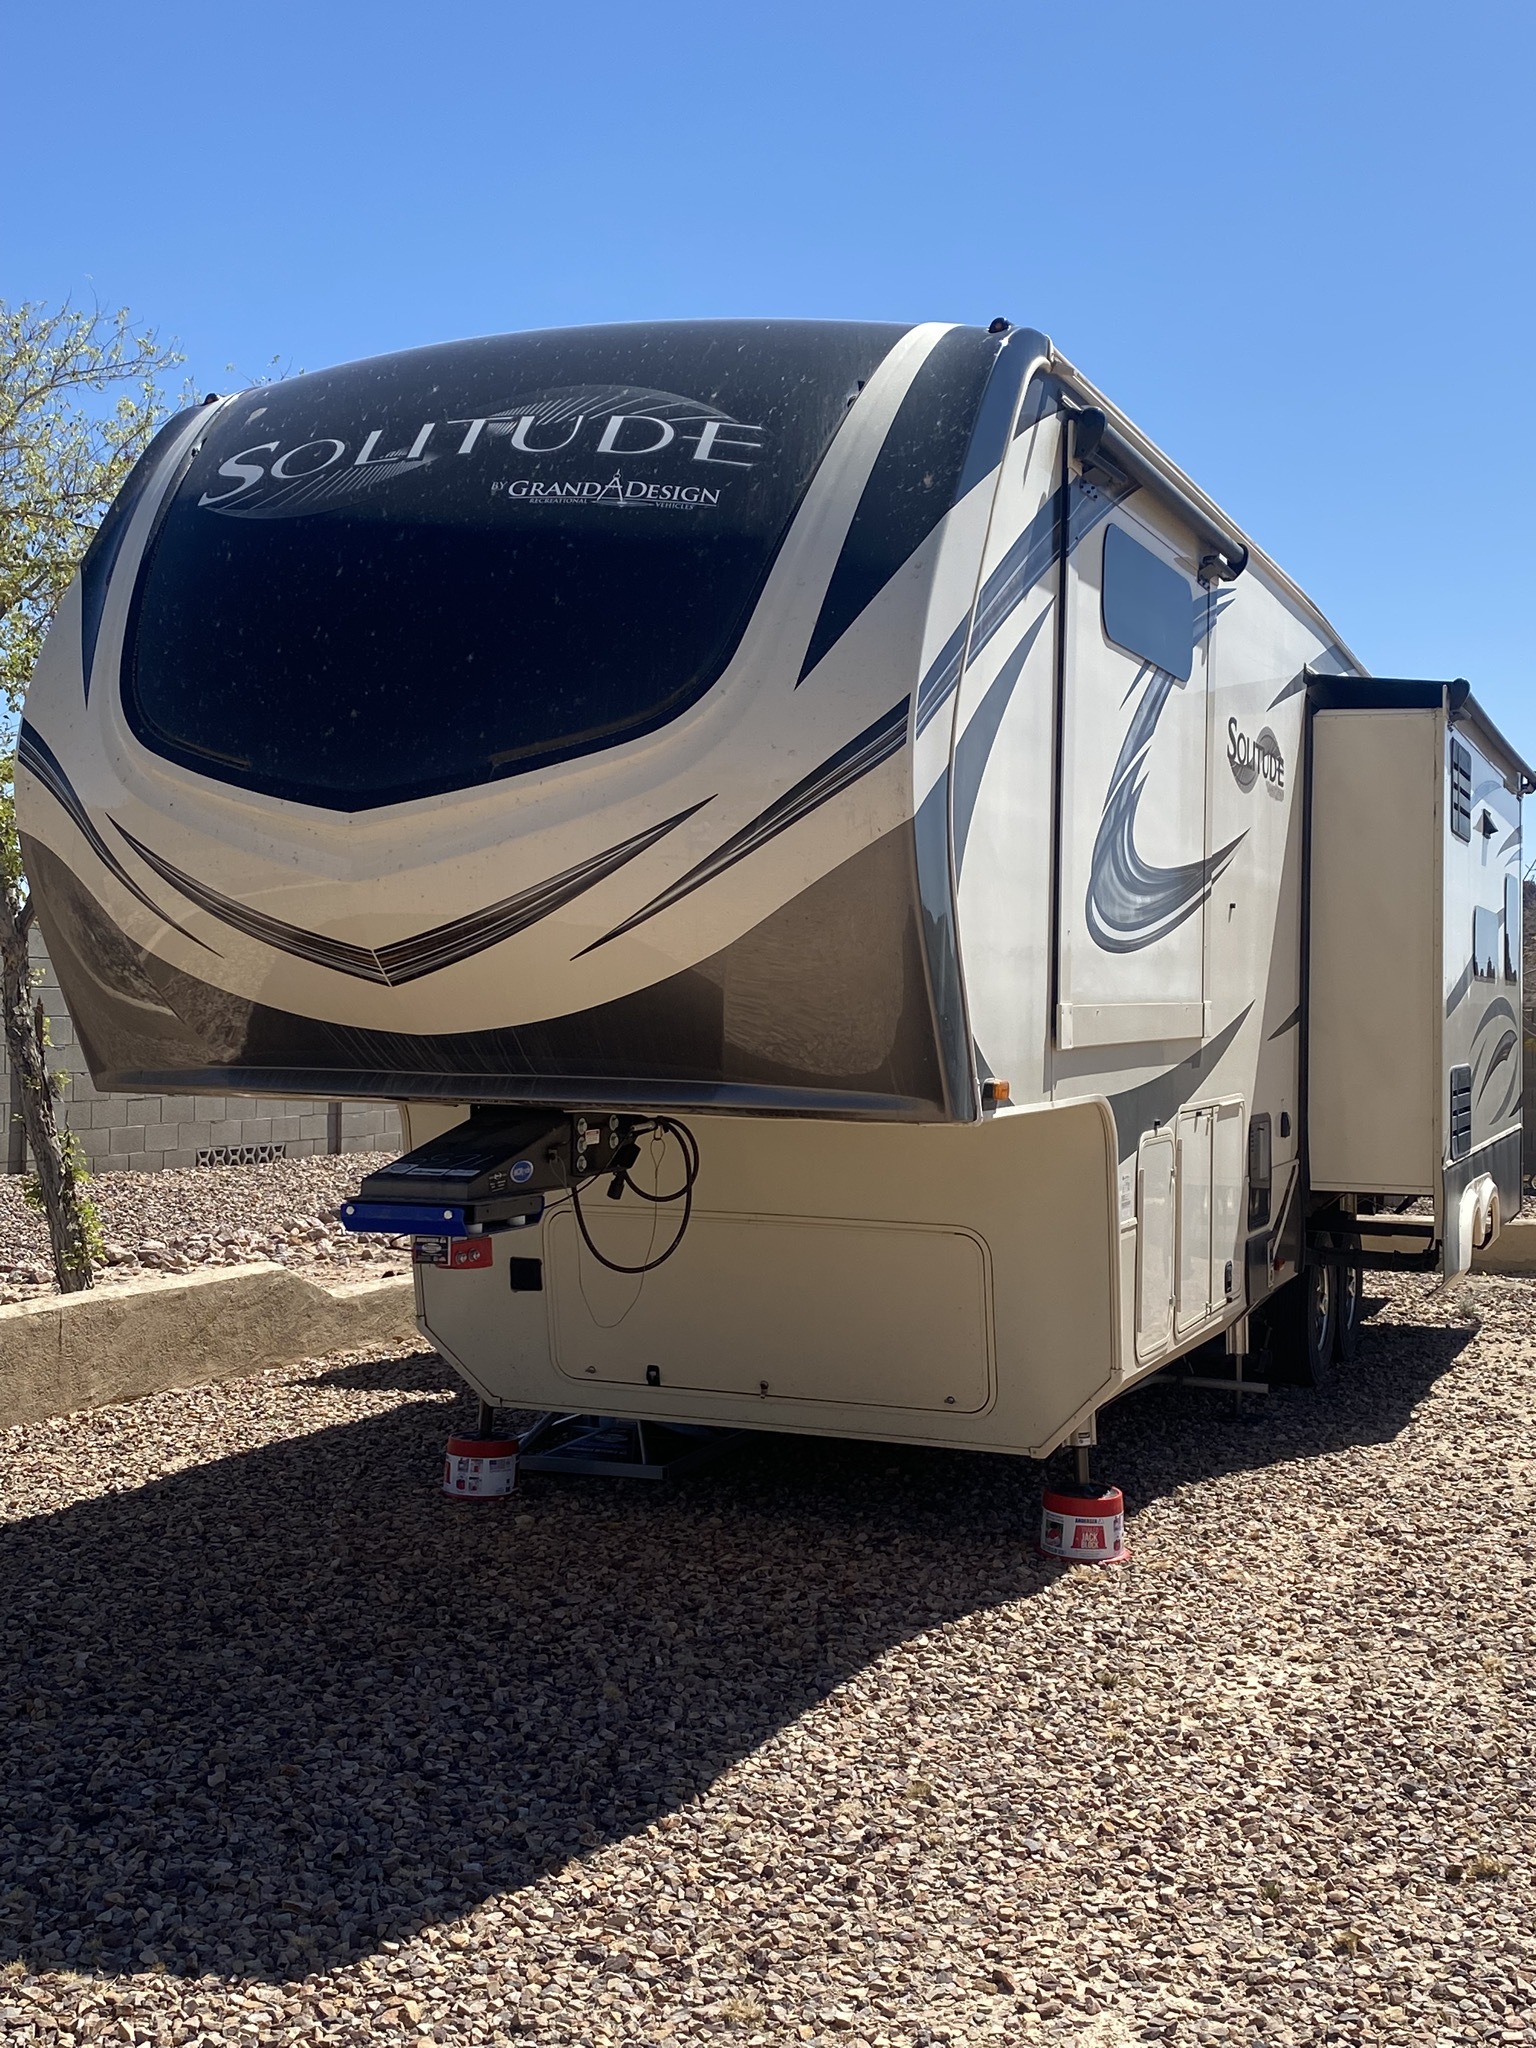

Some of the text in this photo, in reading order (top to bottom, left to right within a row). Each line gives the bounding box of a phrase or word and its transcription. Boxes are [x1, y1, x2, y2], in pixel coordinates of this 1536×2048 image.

[198, 414, 764, 506] SOLITUDE
[491, 480, 721, 504] BY GRAND DESIGN
[529, 497, 695, 511] RECREATIONAL VEHICLES
[1227, 716, 1284, 787] SOLITUDE
